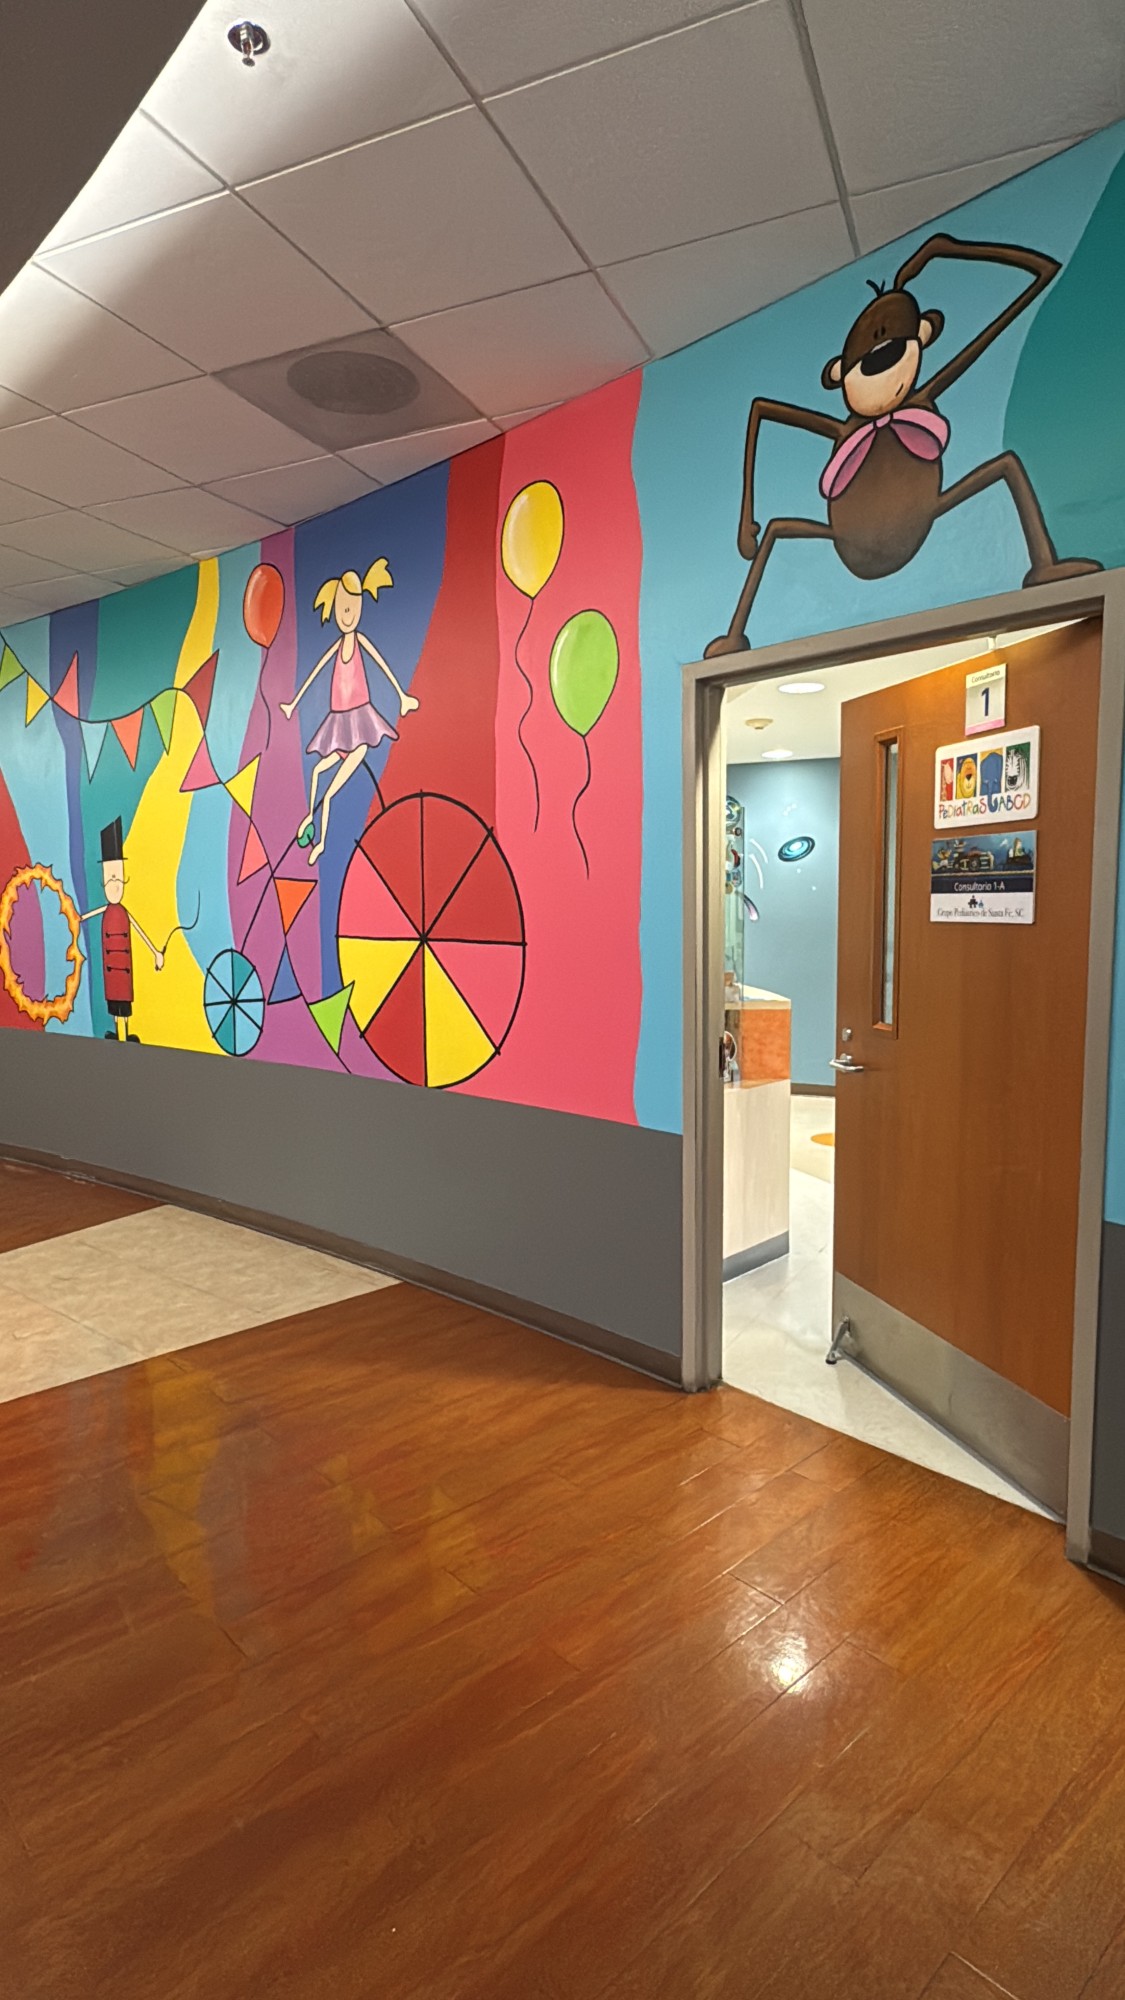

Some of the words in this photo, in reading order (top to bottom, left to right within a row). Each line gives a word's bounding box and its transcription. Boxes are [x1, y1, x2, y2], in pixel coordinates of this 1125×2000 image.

[981, 687, 990, 717] 1
[998, 793, 1031, 812] ABCD
[954, 882, 992, 892] Consultorio
[994, 881, 1005, 891] 1-A
[988, 907, 1003, 917] Santa
